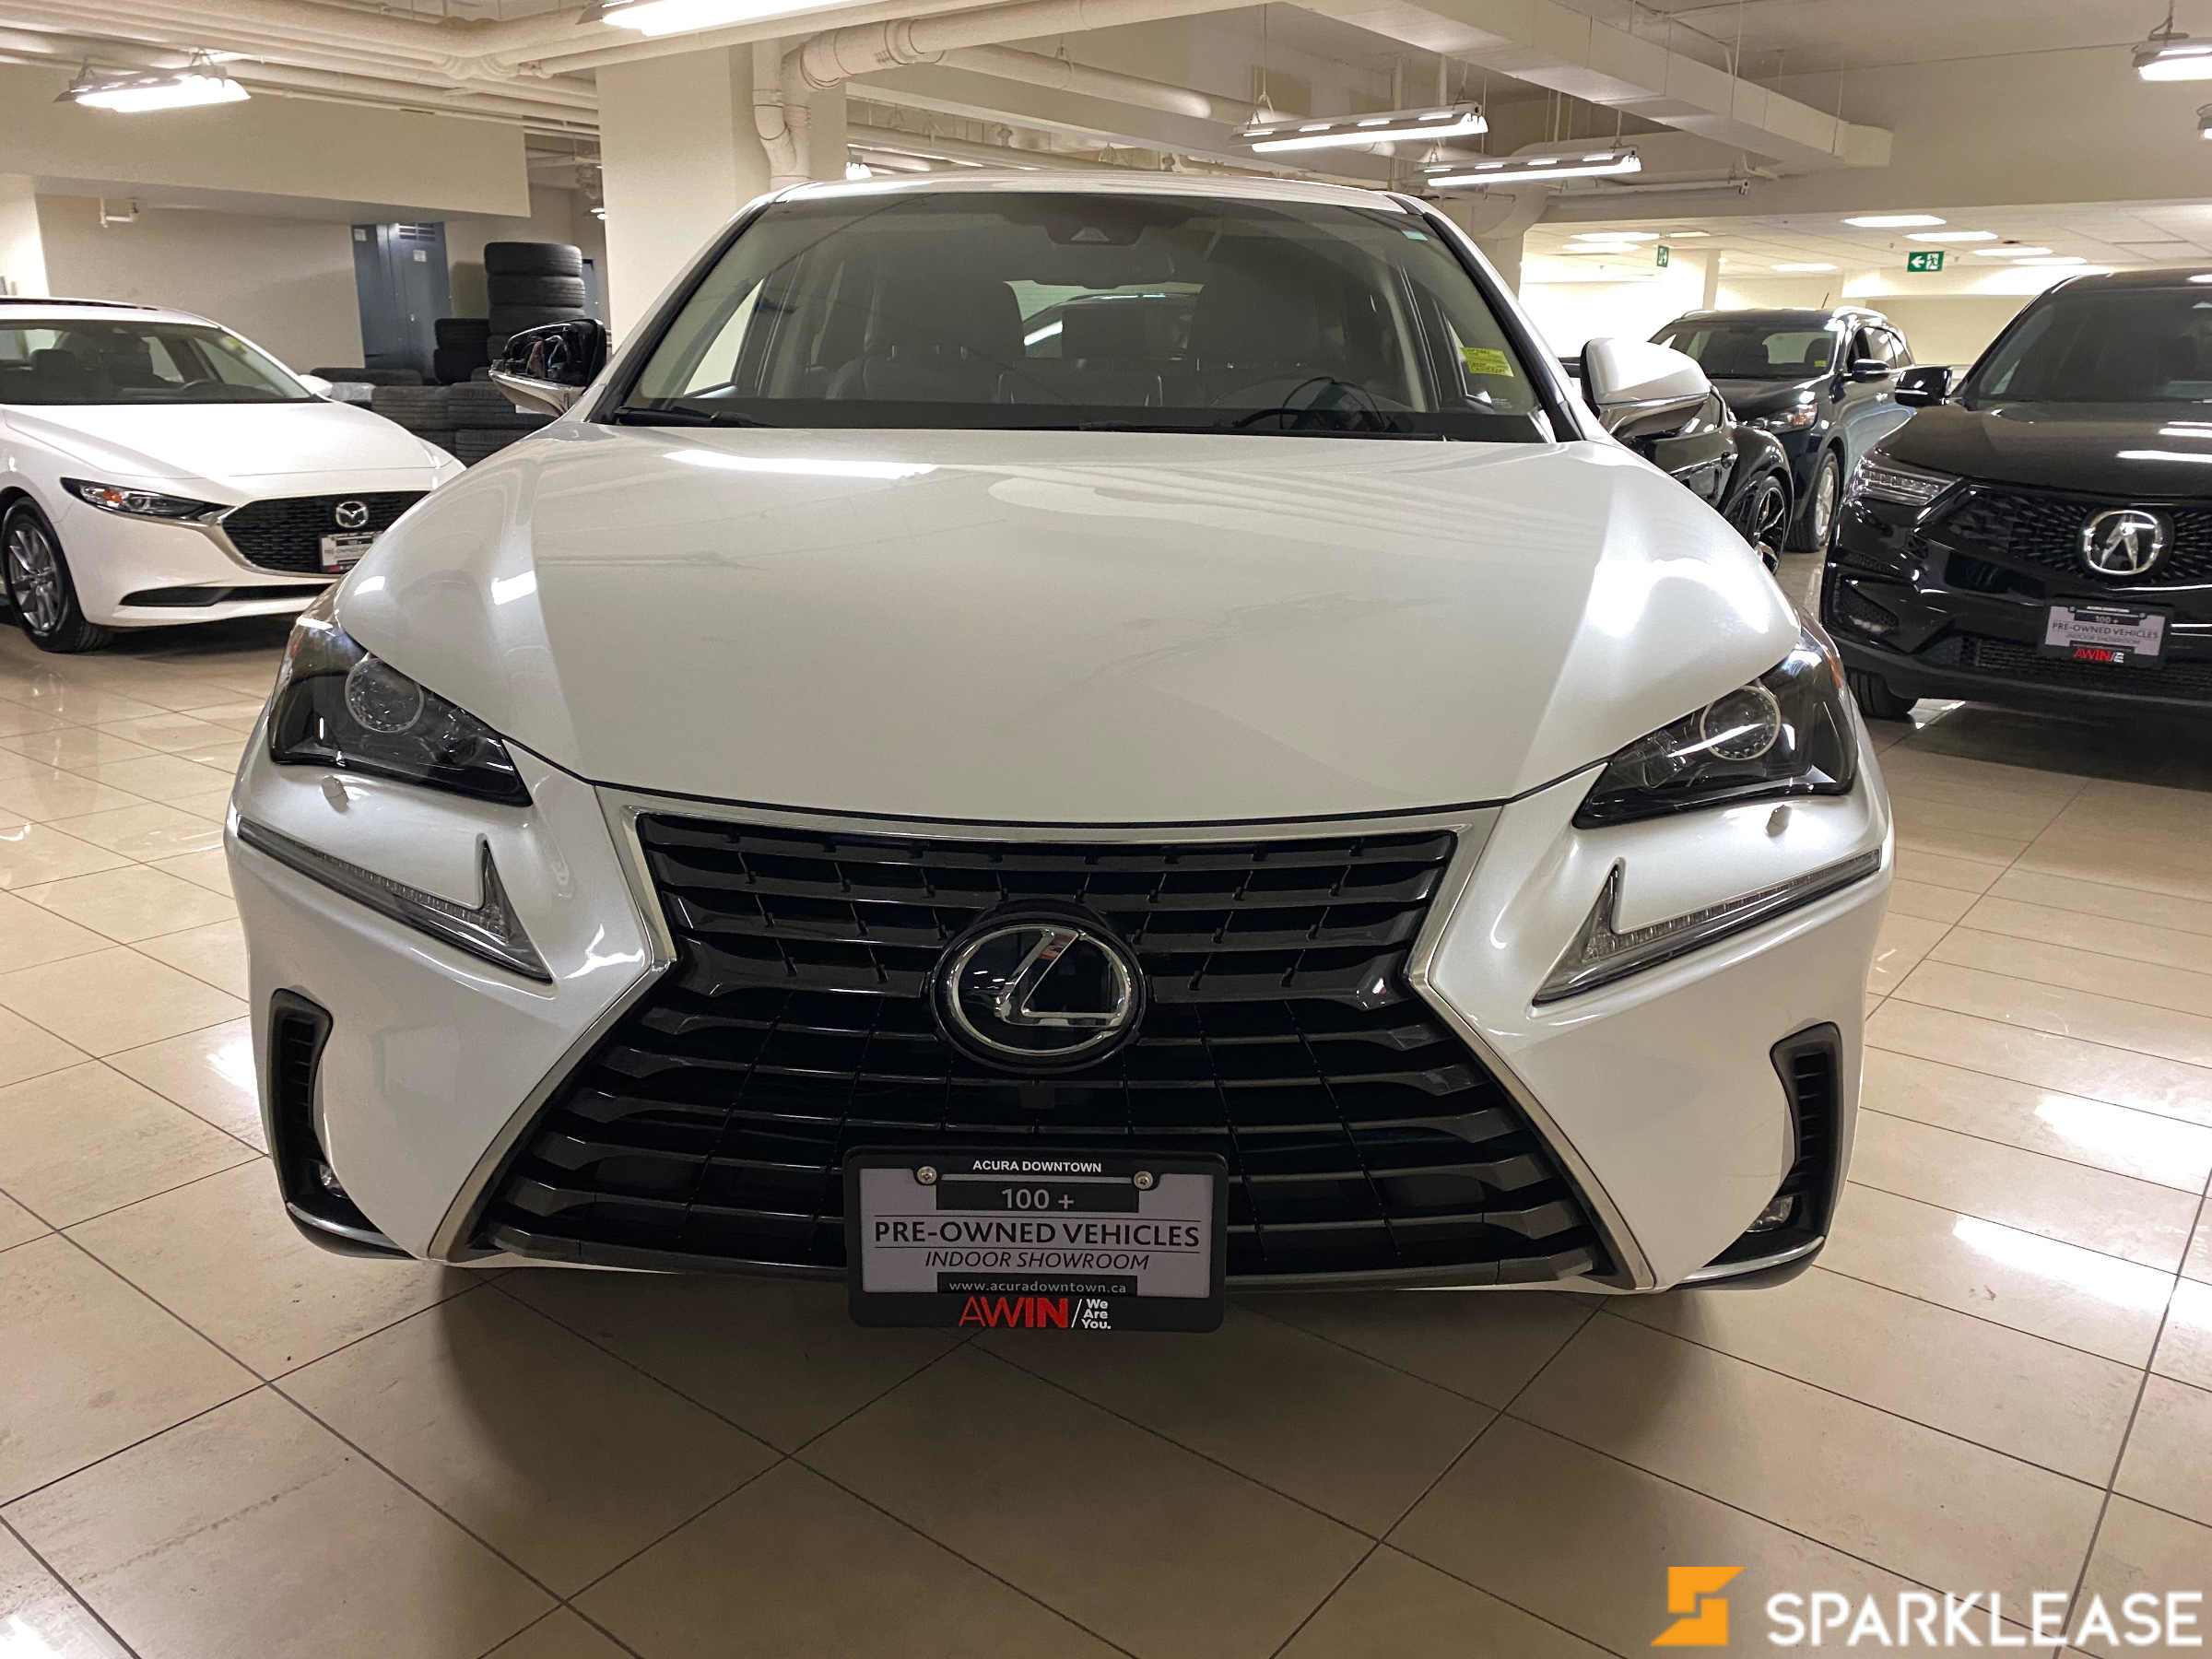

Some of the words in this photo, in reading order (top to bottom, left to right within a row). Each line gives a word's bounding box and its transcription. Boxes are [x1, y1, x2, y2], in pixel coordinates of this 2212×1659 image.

[2053, 622, 2112, 635] PRE-OWNED
[2112, 628, 2158, 639] VEHICLES
[972, 1159, 1019, 1171] ACURA
[1022, 1161, 1101, 1173] DOWNTOWN
[1002, 1188, 1050, 1209] 100
[875, 1221, 1056, 1244] PRE-OWNED
[1063, 1223, 1200, 1247] VEHICLES
[925, 1251, 1011, 1268] INDOOR
[1017, 1252, 1149, 1270] SHOWROOM
[948, 1280, 1126, 1293] www.acuradowntown.ca
[959, 1295, 1069, 1328] AWIN
[1086, 1299, 1109, 1310] We
[1083, 1309, 1109, 1319] Are
[1081, 1319, 1112, 1329] You.
